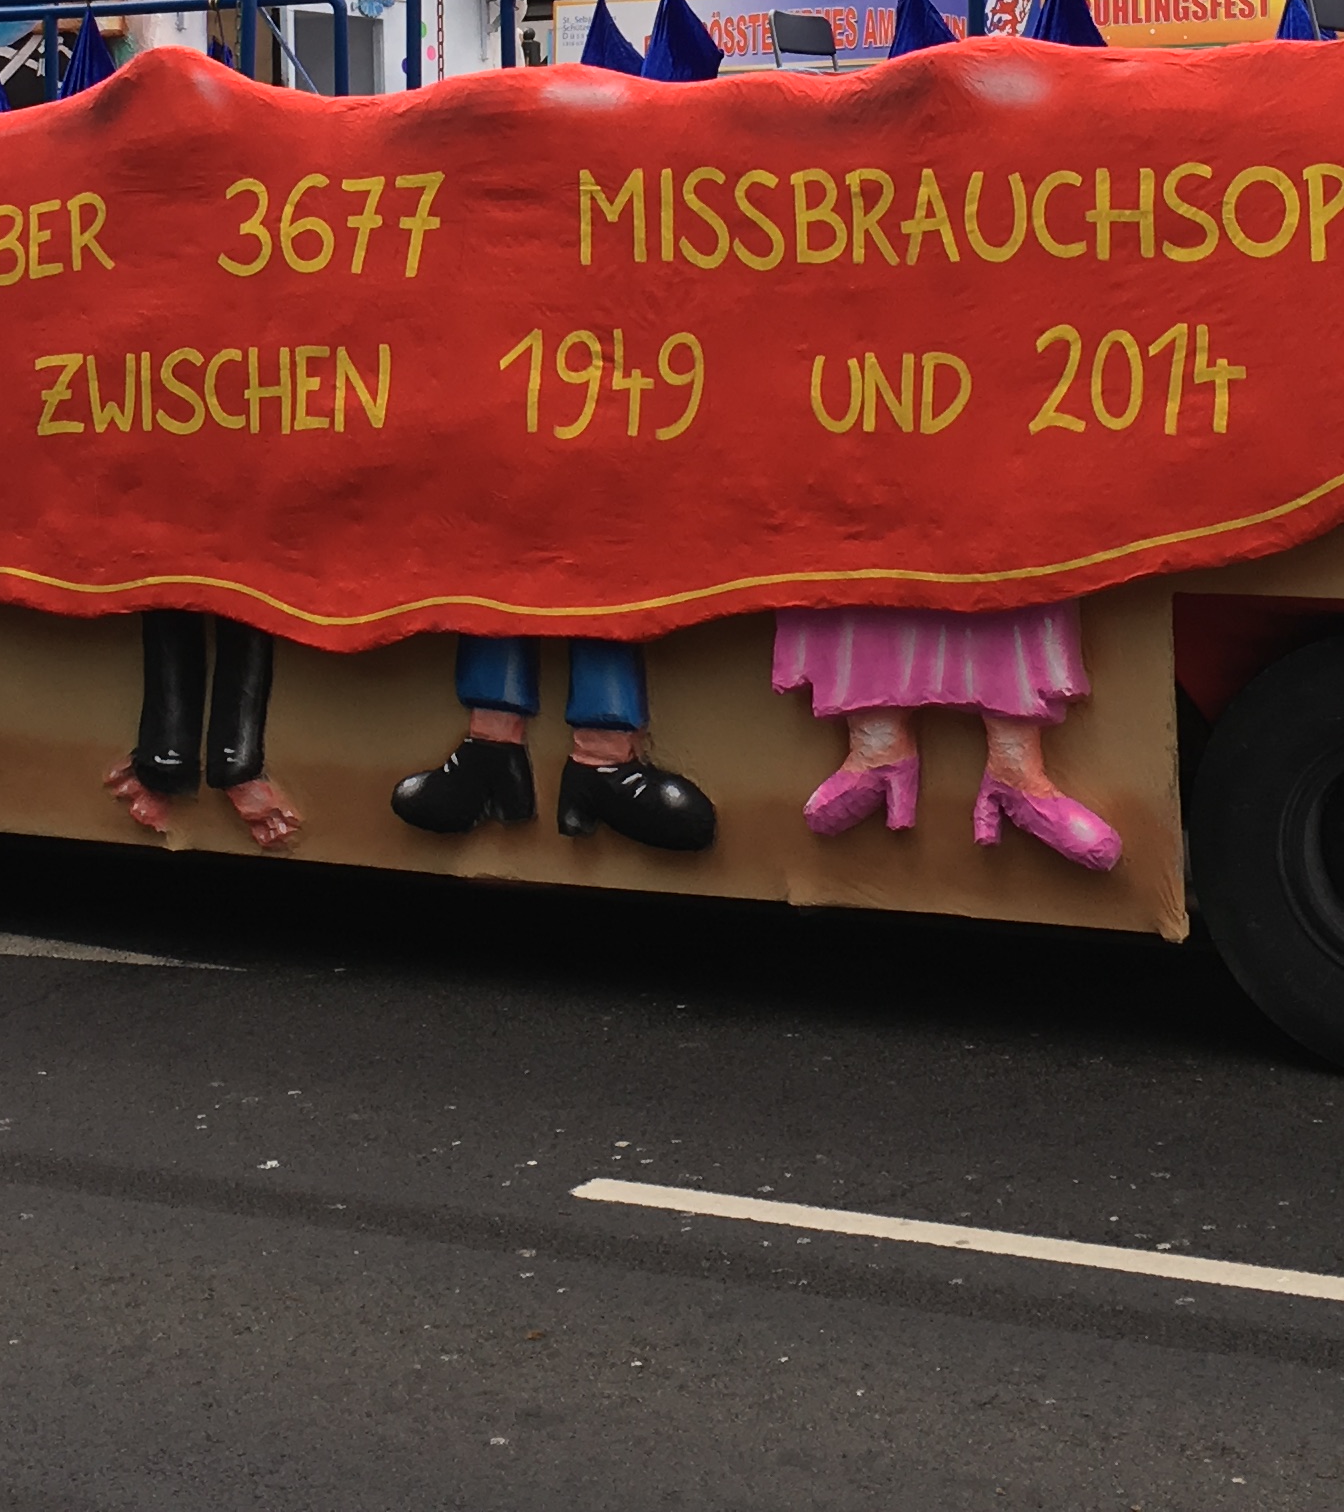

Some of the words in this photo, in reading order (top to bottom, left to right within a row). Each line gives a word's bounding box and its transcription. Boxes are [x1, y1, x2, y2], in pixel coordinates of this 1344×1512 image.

[217, 172, 445, 278] 3677
[34, 343, 392, 437] ZWISCHEN
[499, 327, 705, 441] 1949
[810, 351, 973, 436] UND
[1028, 322, 1248, 436] 2014
